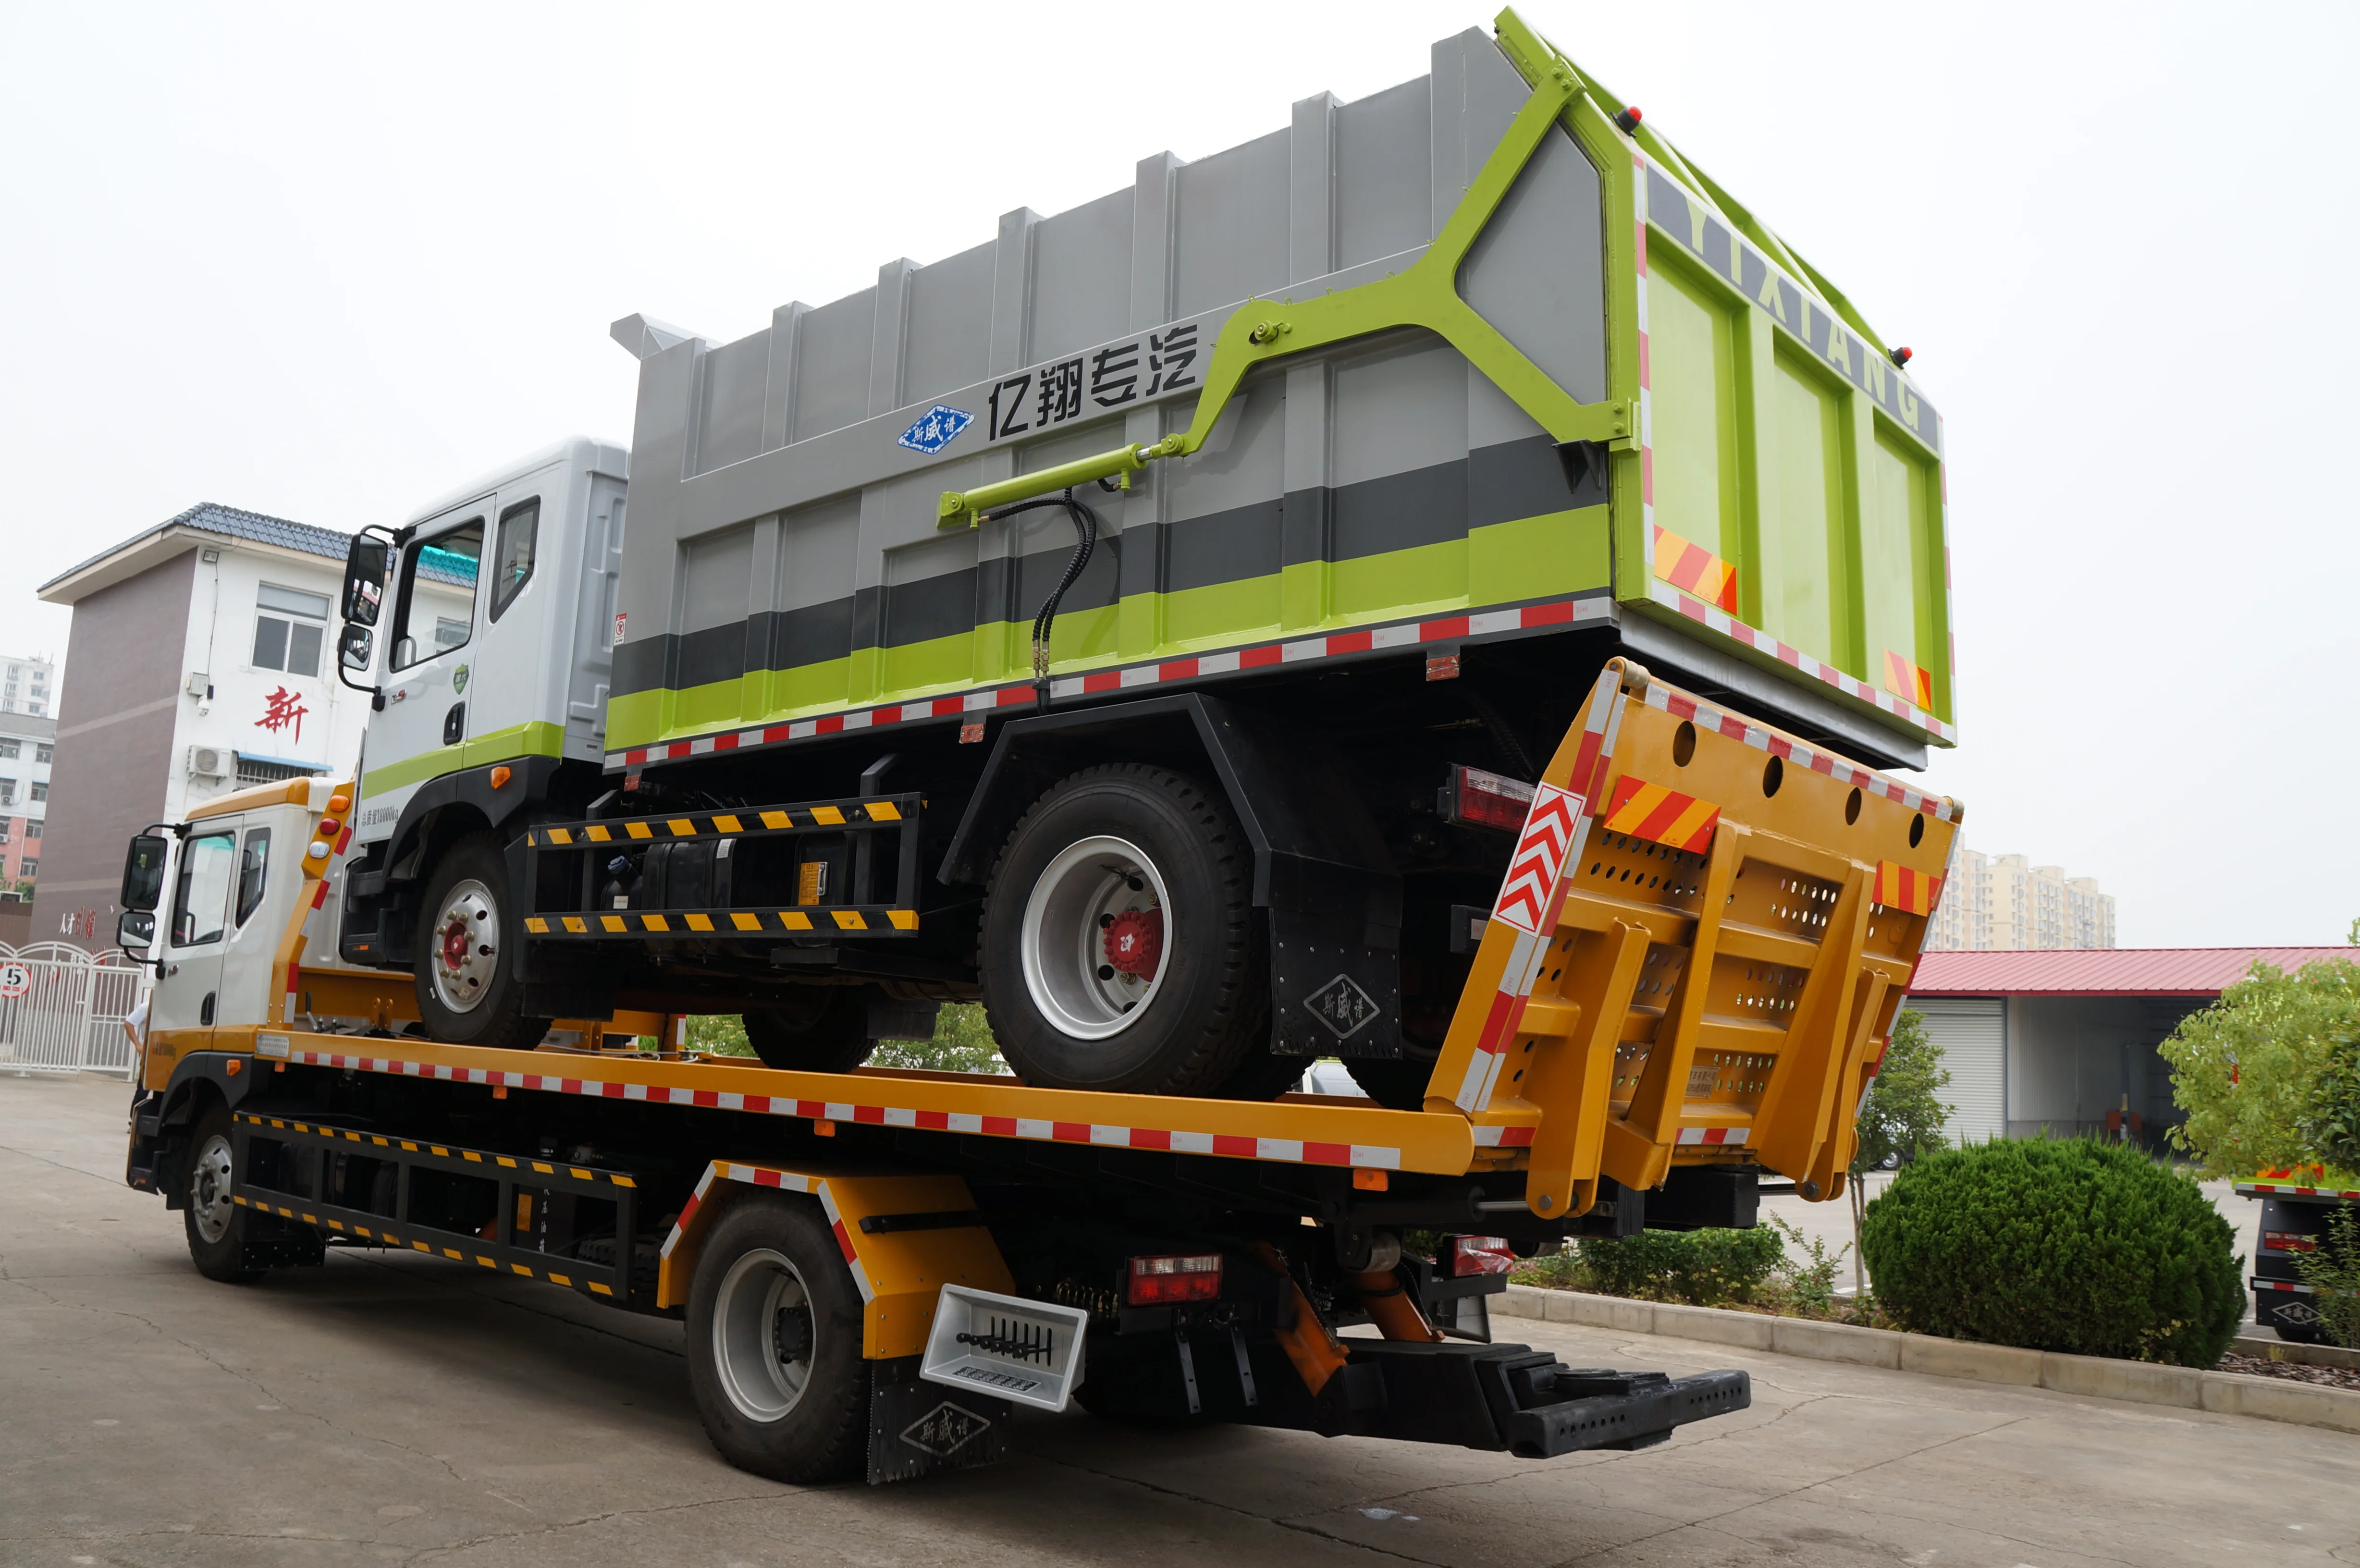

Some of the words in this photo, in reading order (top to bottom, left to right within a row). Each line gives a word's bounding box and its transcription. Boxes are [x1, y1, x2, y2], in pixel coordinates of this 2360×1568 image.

[1685, 194, 1919, 432] YIXIANG
[988, 324, 1198, 442] 亿翔专汽
[254, 685, 309, 746] 新
[361, 805, 398, 826] 总质量18000kg
[7, 968, 21, 985] 5
